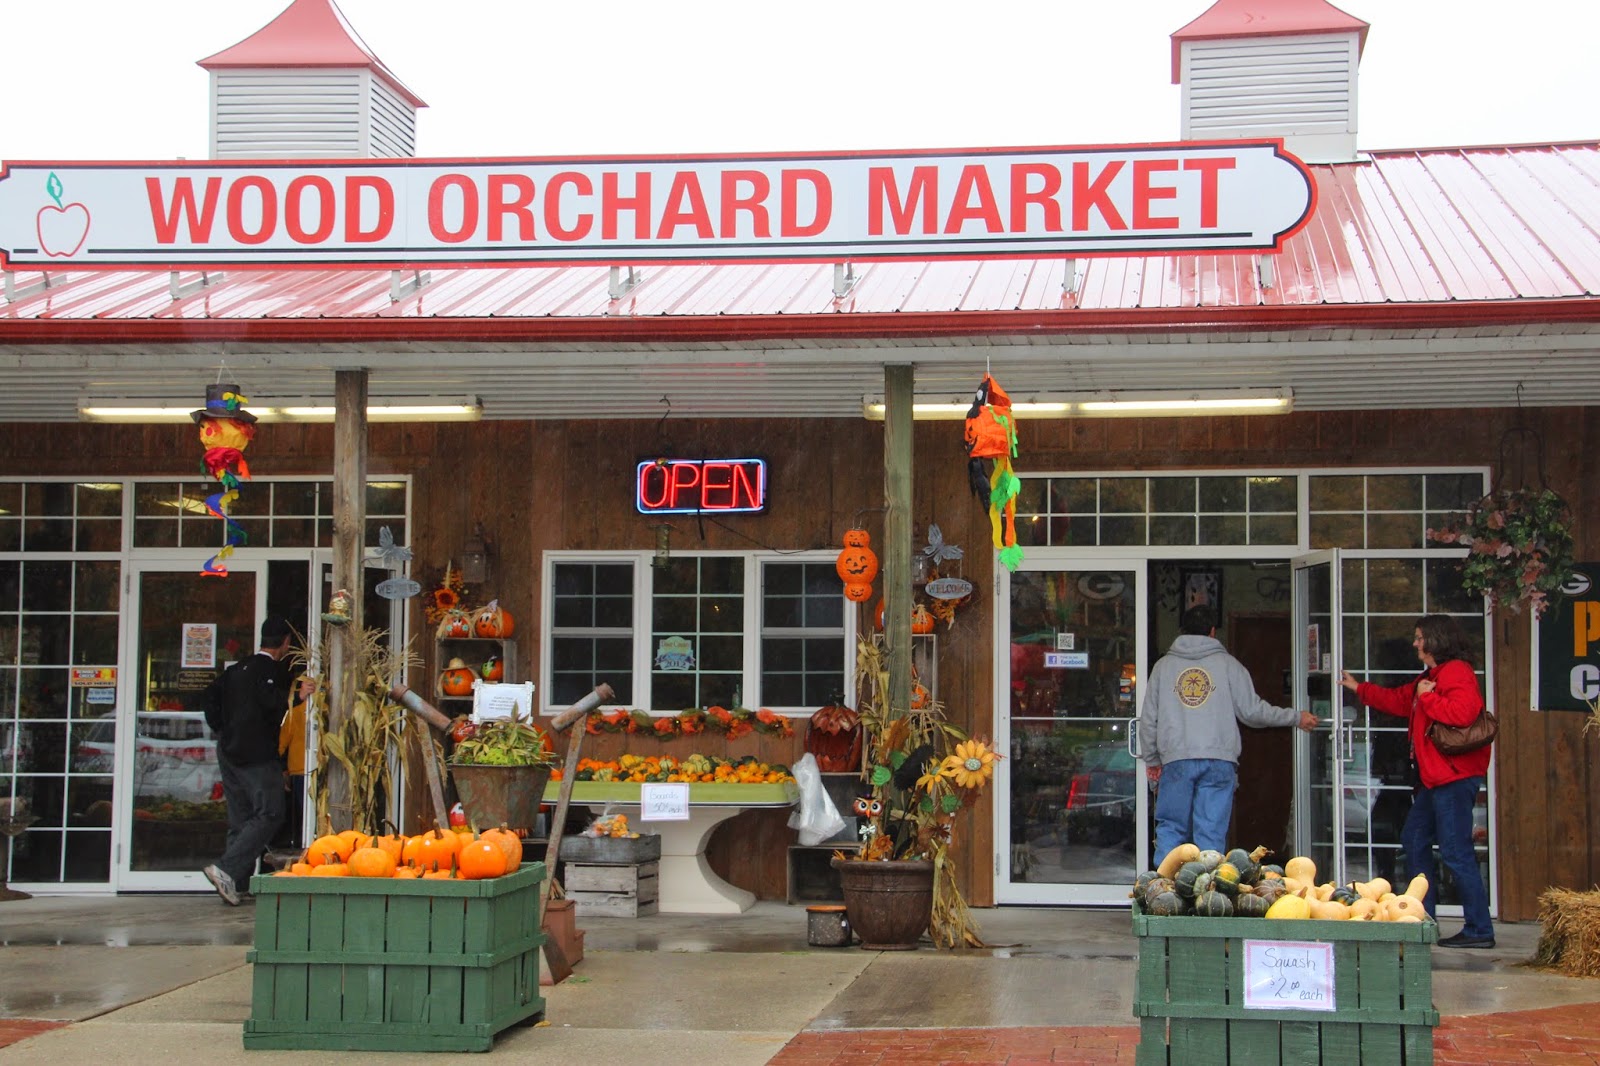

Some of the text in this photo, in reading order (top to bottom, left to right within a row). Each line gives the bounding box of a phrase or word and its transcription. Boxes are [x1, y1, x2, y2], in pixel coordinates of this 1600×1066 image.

[145, 156, 1237, 245] WOOD ORCHARD MARKET
[641, 463, 762, 508] OPEN
[664, 660, 686, 669] 2012
[1261, 947, 1316, 977] Squash
[1299, 988, 1323, 1001] each
